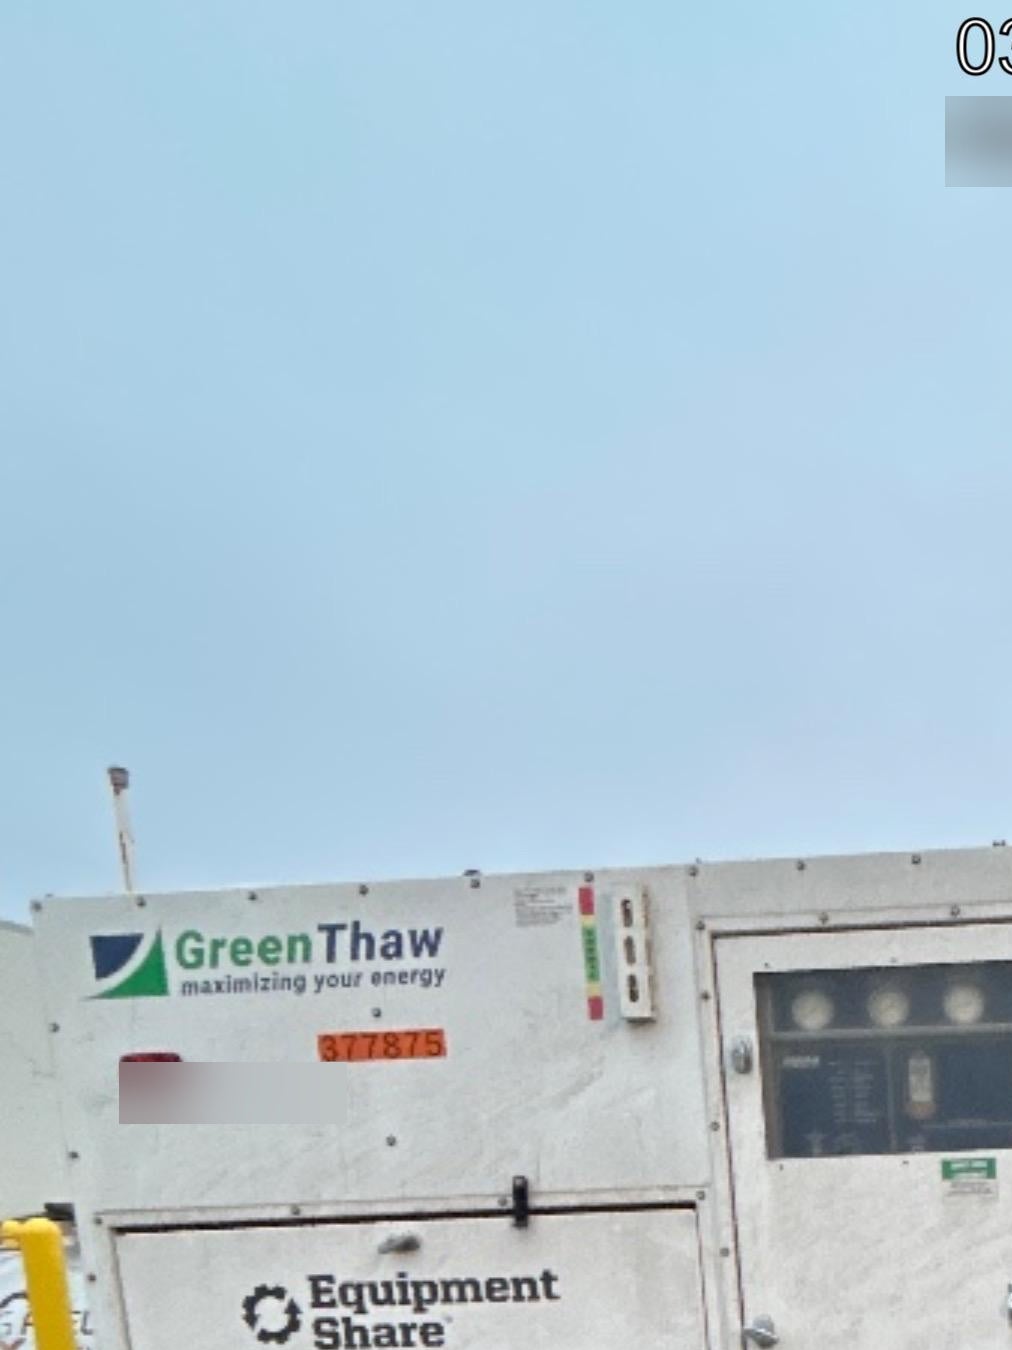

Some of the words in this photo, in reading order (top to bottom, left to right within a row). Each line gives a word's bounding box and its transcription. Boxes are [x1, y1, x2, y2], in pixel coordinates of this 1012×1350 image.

[181, 971, 307, 997] maximizing
[314, 971, 364, 994] your
[371, 967, 446, 988] energy
[321, 1031, 444, 1062] 377875
[307, 1268, 562, 1315] Equipment
[312, 1316, 445, 1350] Share
